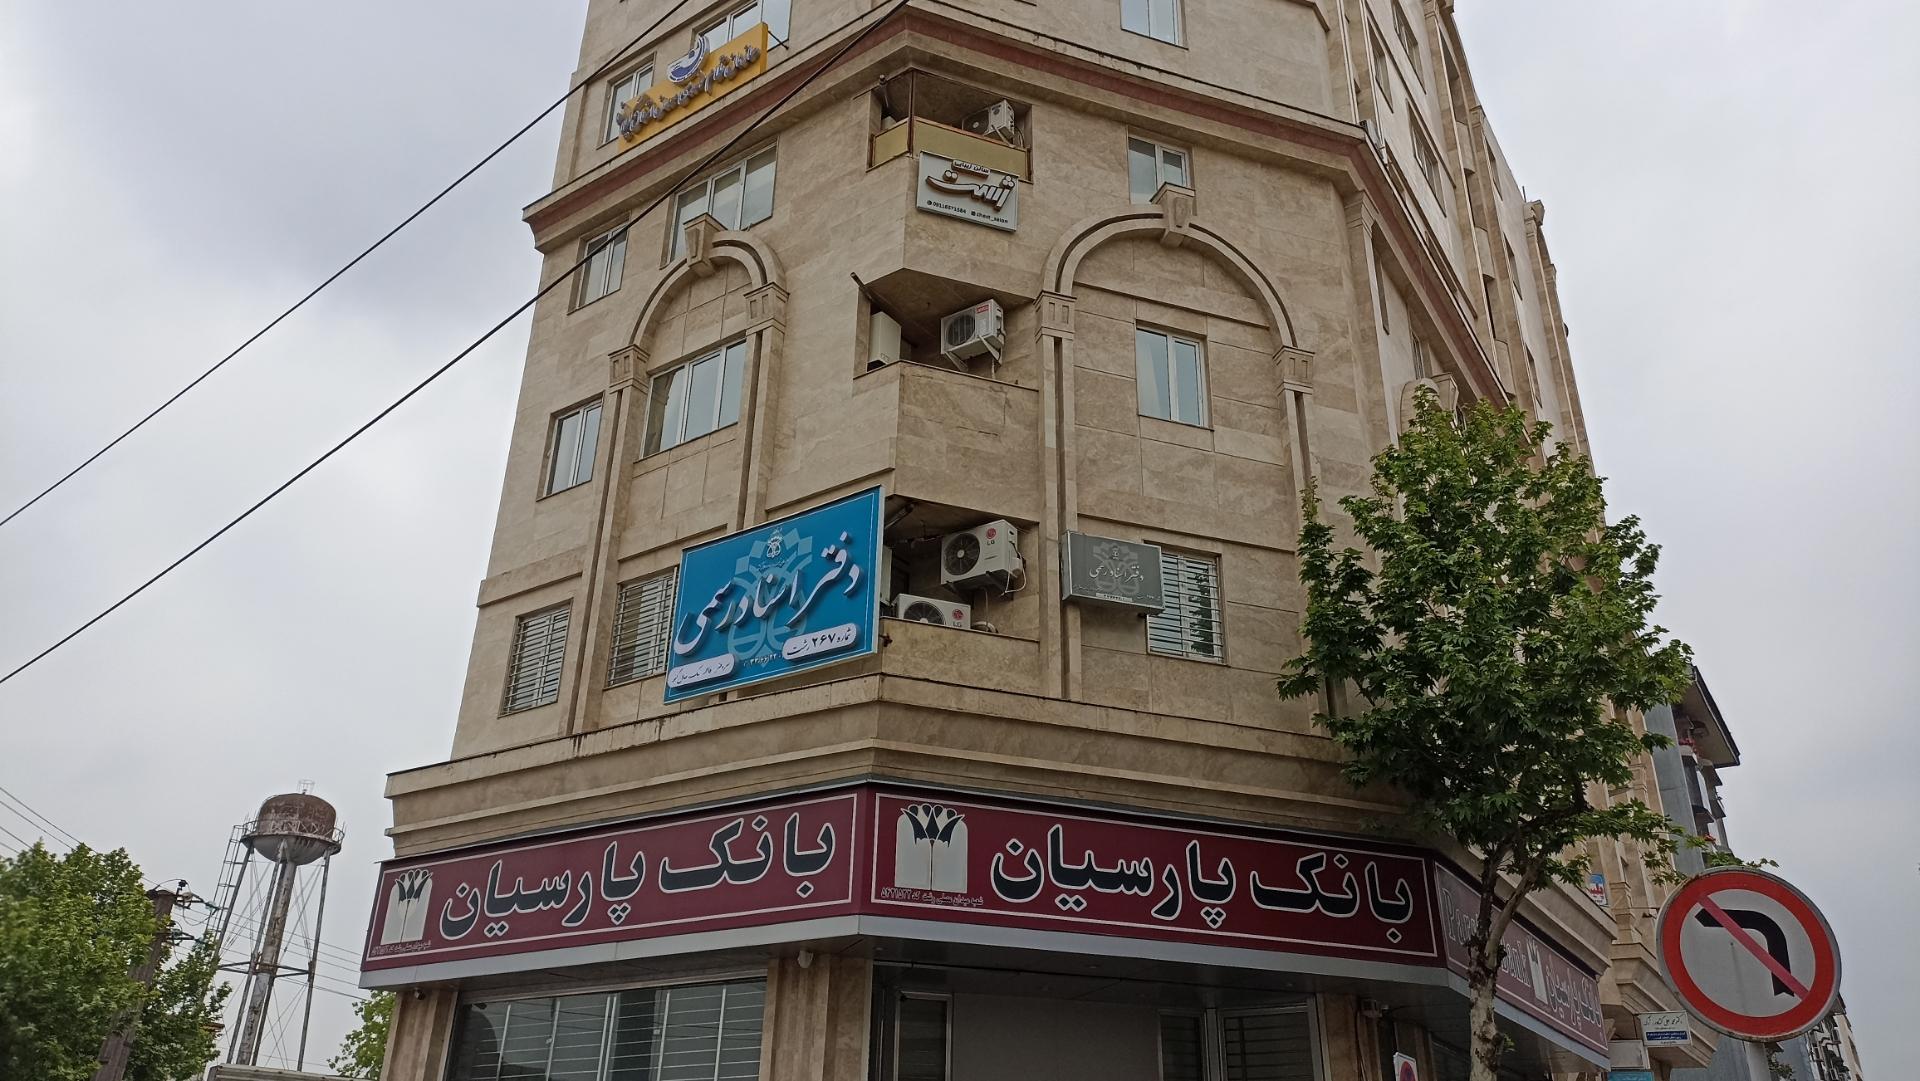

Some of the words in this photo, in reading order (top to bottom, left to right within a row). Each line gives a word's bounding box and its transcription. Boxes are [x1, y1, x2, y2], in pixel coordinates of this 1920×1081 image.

[732, 569, 800, 625] اسناد
[786, 530, 861, 628] دفتر
[1089, 564, 1108, 578] رسمی
[1110, 567, 1127, 579] اسناد
[1125, 564, 1145, 583] دفتر
[673, 579, 738, 656] رسمی
[786, 639, 810, 655] رشت
[812, 633, 836, 647] ۲۶۷
[836, 627, 851, 643] شماره
[659, 811, 836, 898] بانک
[990, 822, 1237, 929] پارسیان
[439, 840, 648, 941] پارسیان
[1250, 852, 1415, 945] بانک
[1546, 953, 1582, 1031] پارسیان
[1581, 976, 1604, 1044] بانک
